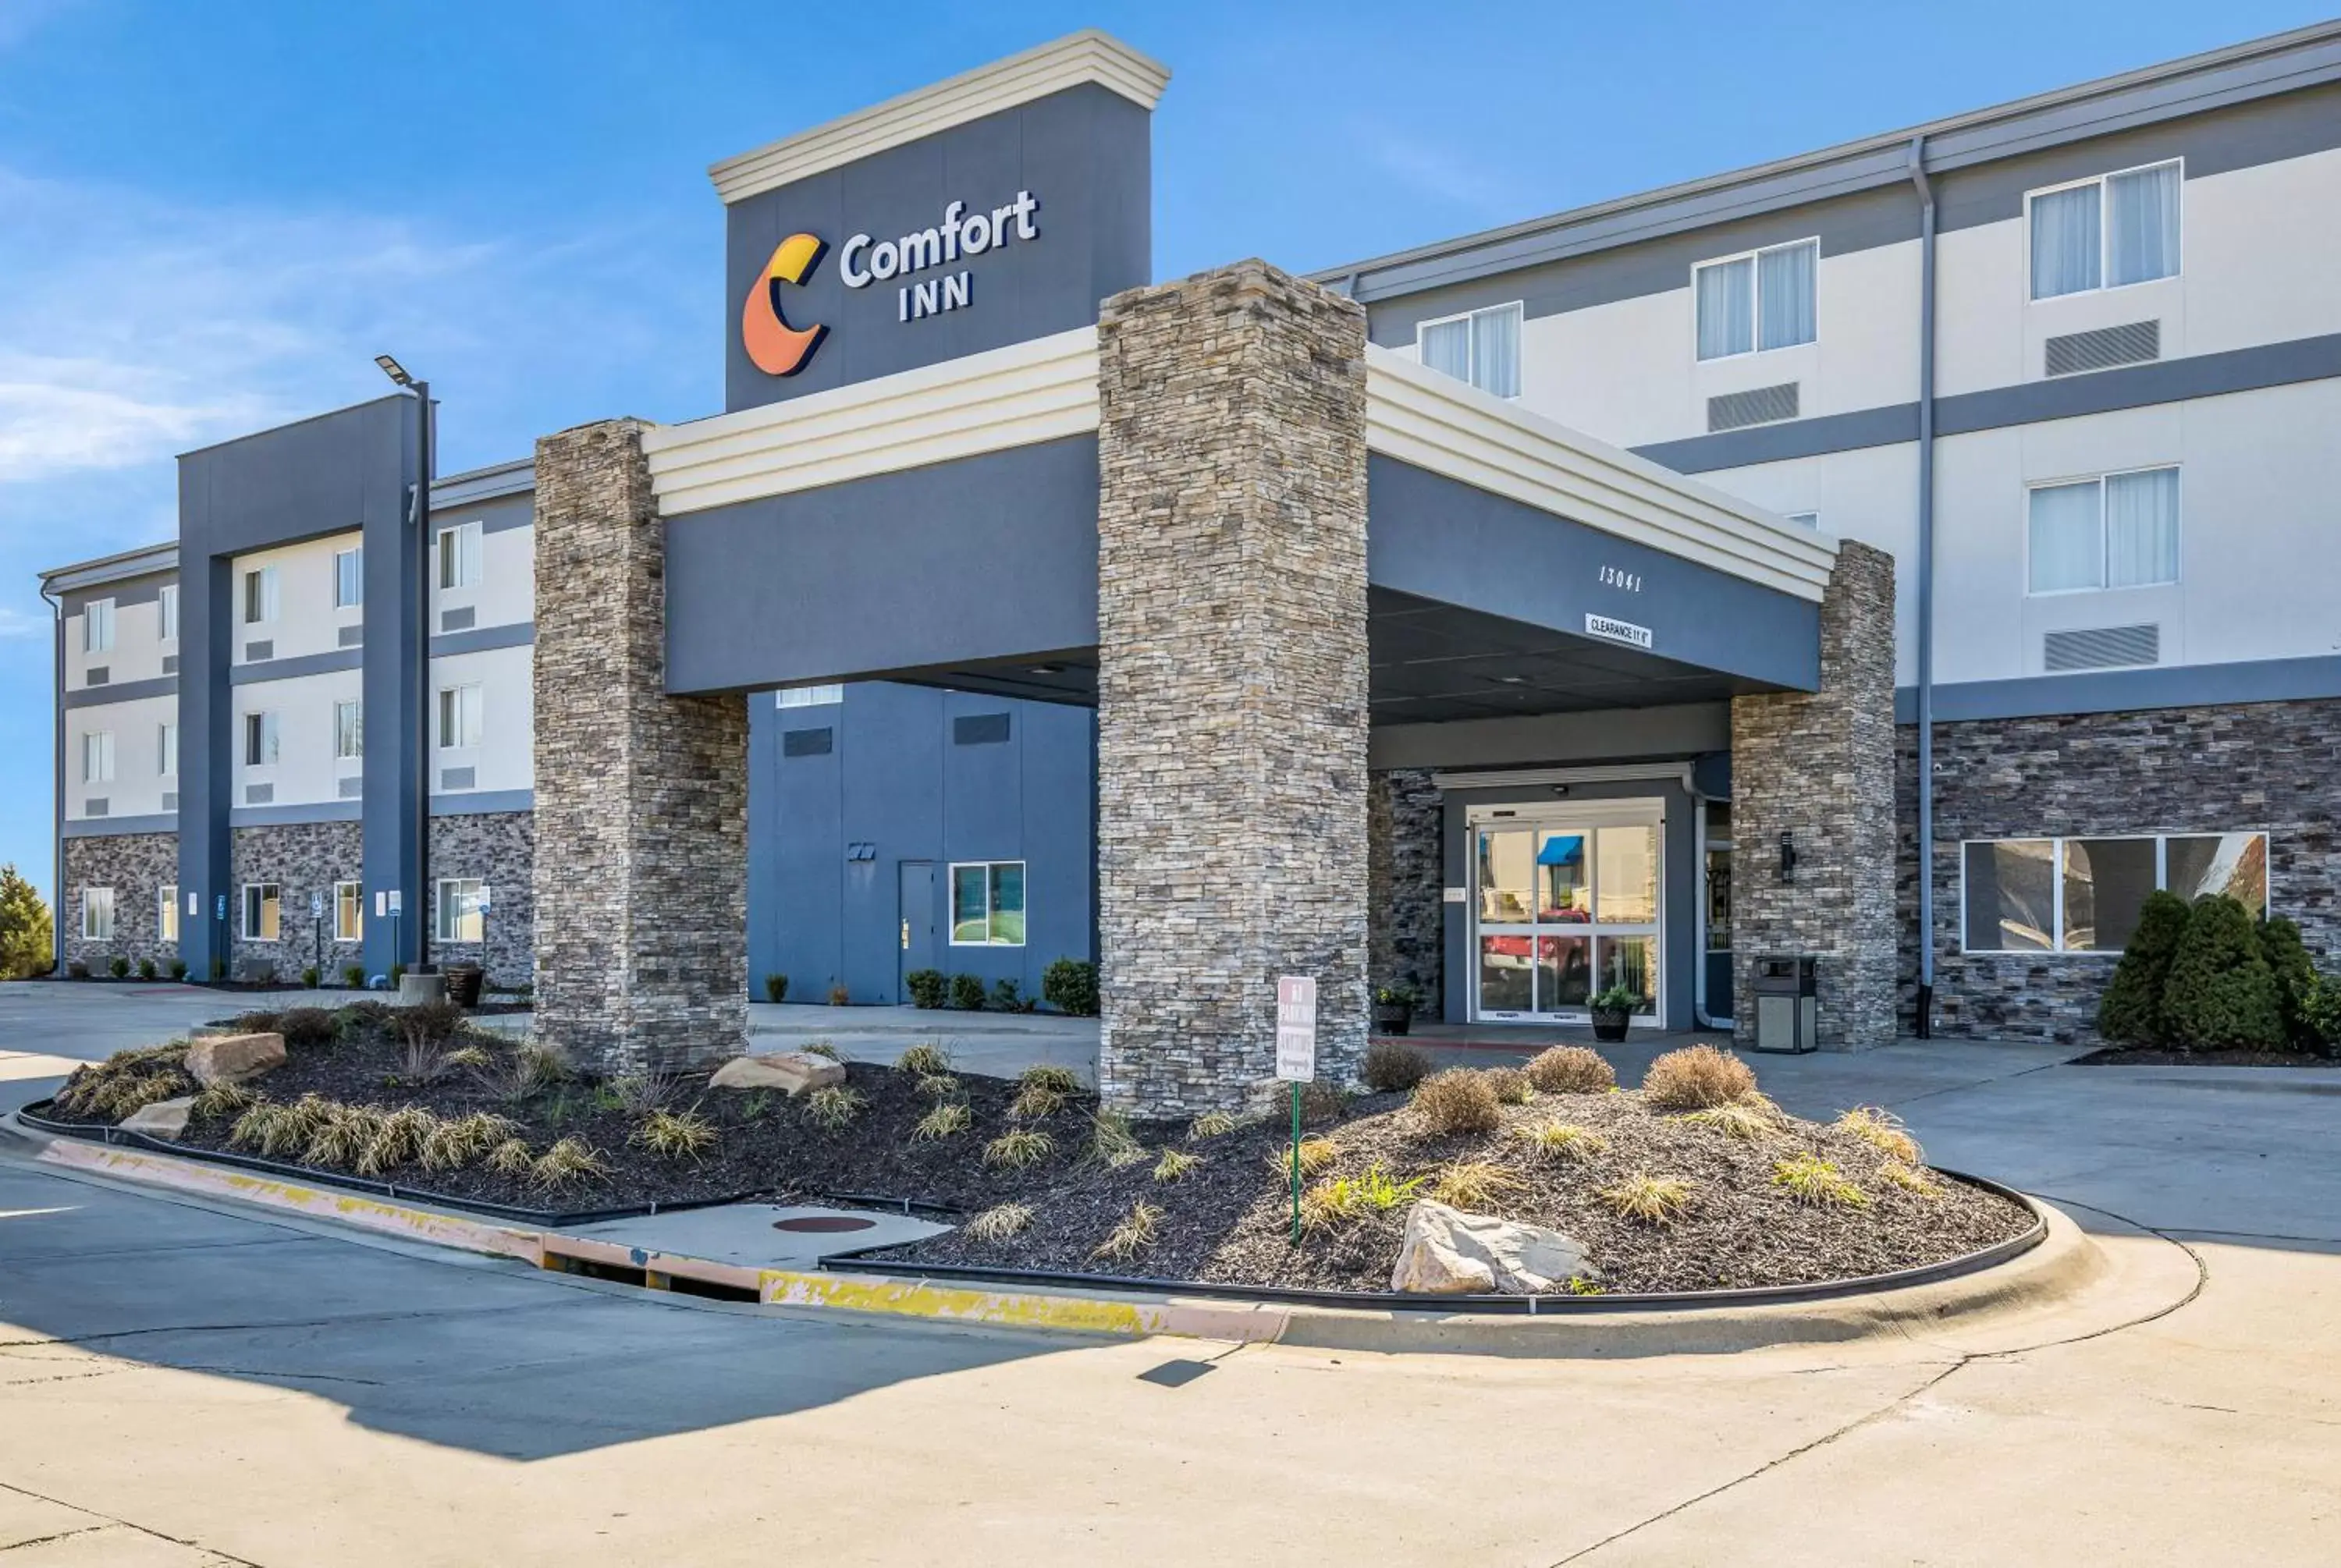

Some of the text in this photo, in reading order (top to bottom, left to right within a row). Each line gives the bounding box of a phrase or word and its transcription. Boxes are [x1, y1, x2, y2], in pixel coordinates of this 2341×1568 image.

[840, 190, 1038, 288] Comfort
[899, 271, 972, 322] INN
[1599, 566, 1641, 592] 13041
[1591, 618, 1632, 639] CLEARANCE
